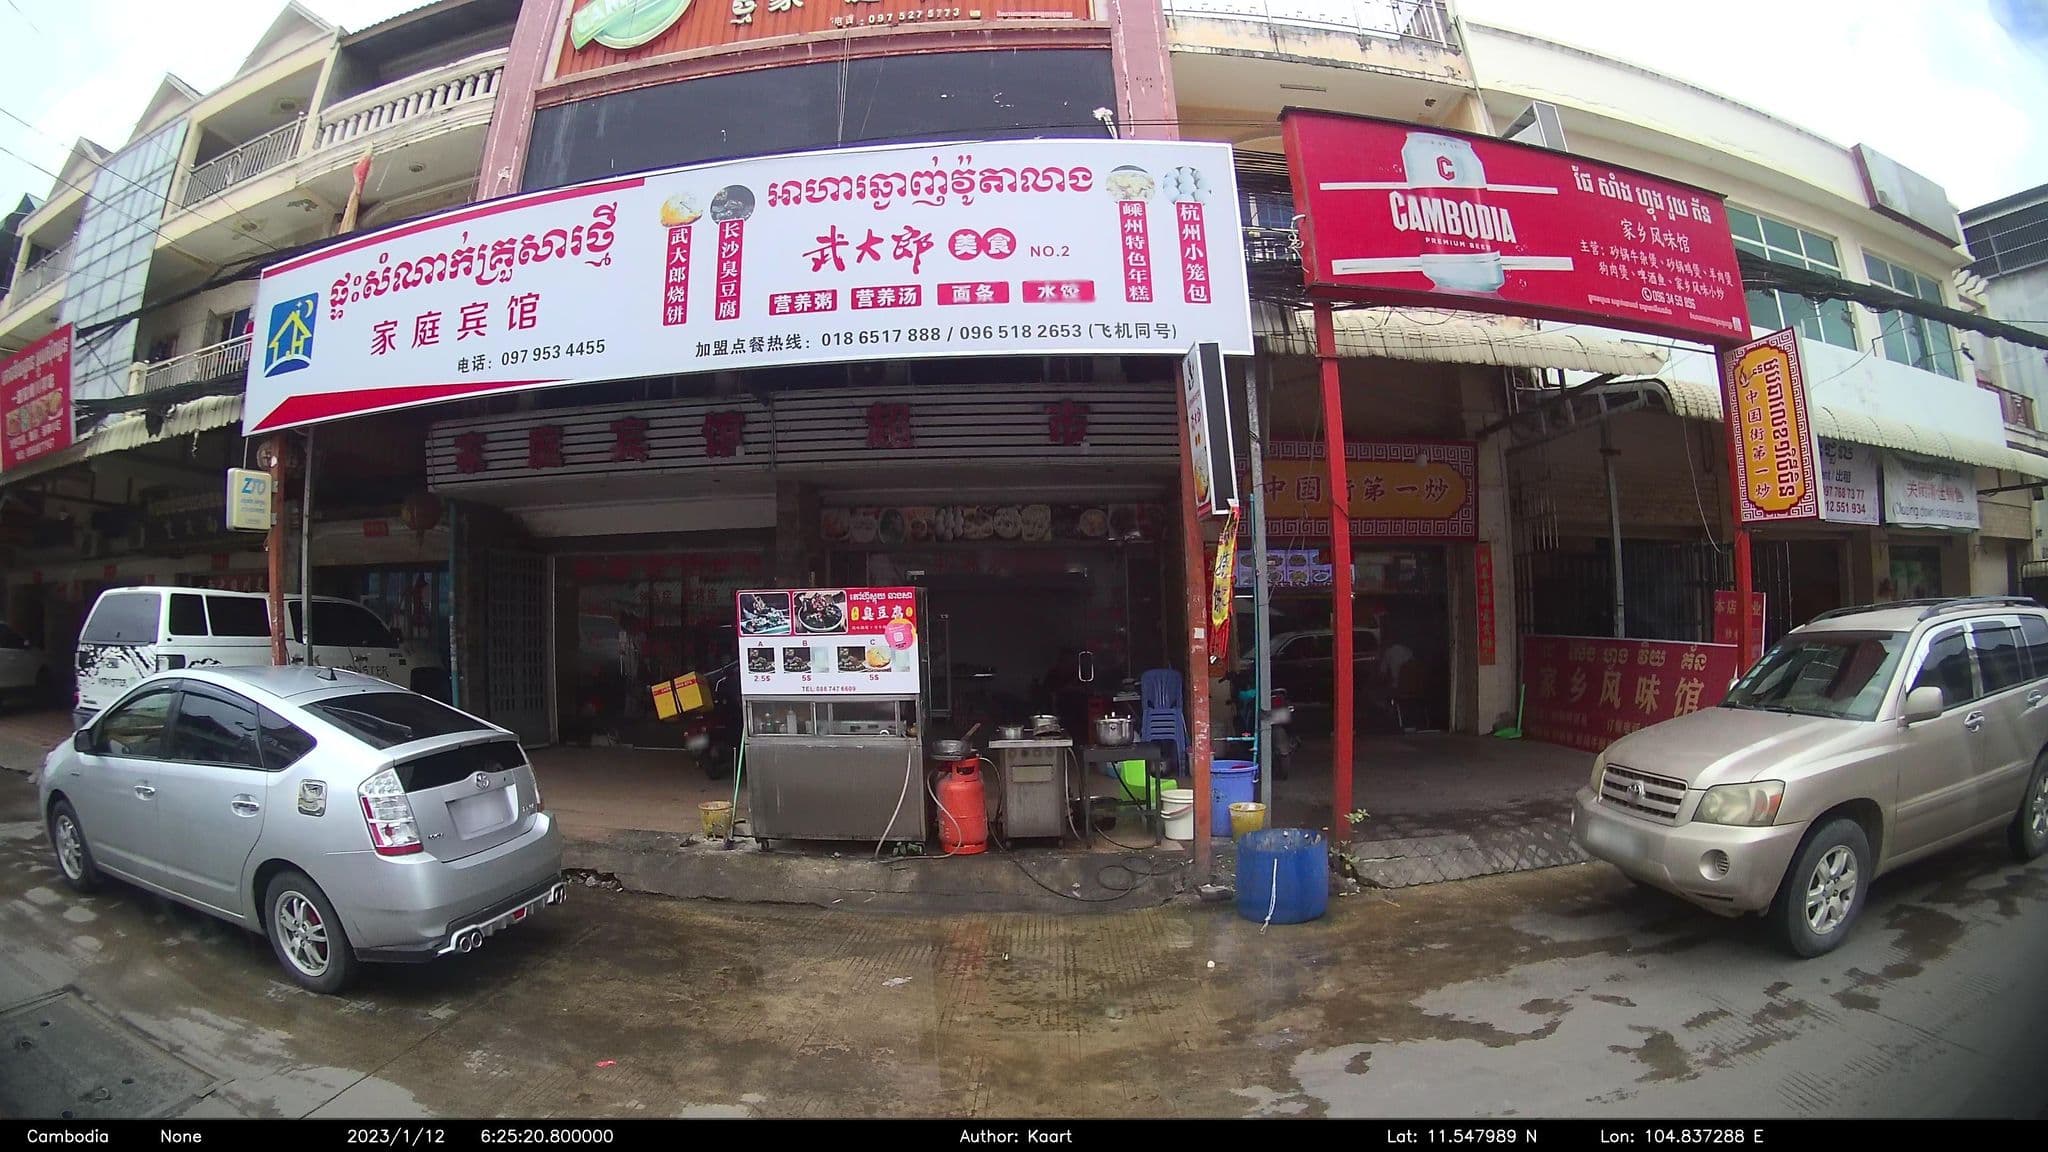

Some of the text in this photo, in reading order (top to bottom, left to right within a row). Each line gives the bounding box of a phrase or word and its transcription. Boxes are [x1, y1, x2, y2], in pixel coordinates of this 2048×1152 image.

[869, 13, 894, 24] 097
[899, 11, 922, 21] 527
[1388, 190, 1517, 245] CAMBODIA
[1425, 236, 1491, 253] PREMIUM BEER
[1620, 218, 1690, 254] 家乡风味馆
[802, 224, 1070, 275] 武大郎 美食 NO.2
[1179, 203, 1208, 302] 杭州小笼包
[667, 228, 690, 325] 武大郎烧饼
[717, 220, 742, 320] 长沙臭豆腐
[773, 292, 833, 312] 营养粥
[855, 288, 918, 308] 营养汤
[951, 284, 995, 304] 面条
[370, 292, 541, 356] 家庭宾馆
[822, 331, 855, 346] 018
[858, 329, 904, 344] 6517
[908, 327, 942, 342] 888
[959, 326, 994, 340] 096
[997, 325, 1033, 339] 518
[1037, 323, 1083, 338] 2653
[501, 350, 529, 367] 097
[532, 346, 561, 363] 953
[565, 339, 606, 359] 4455
[241, 477, 266, 496] ZTO
[1836, 503, 1849, 513] 551
[1851, 504, 1866, 515] 934
[861, 604, 904, 621] 臭豆腐
